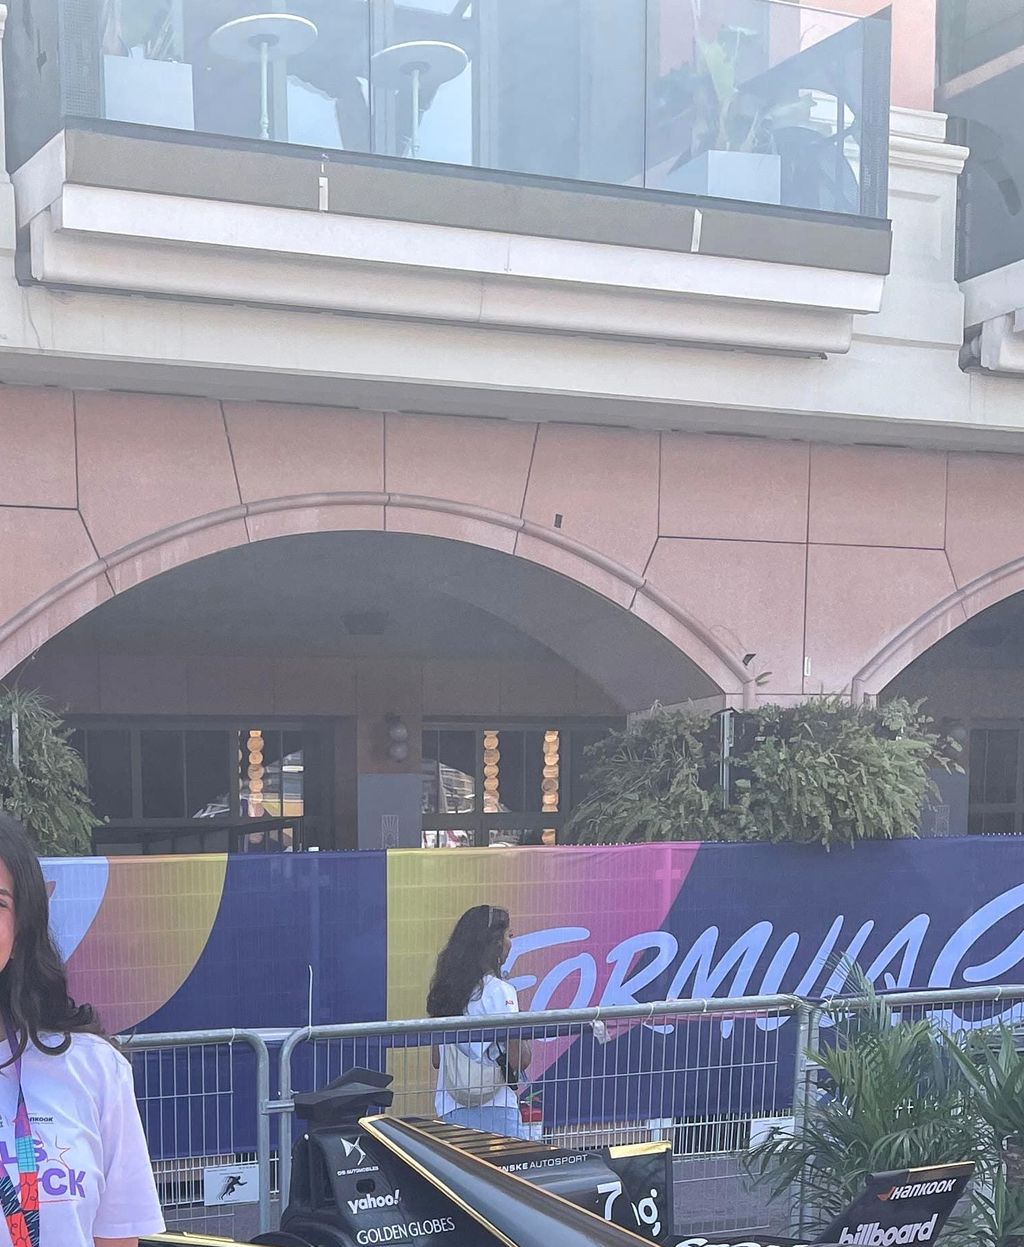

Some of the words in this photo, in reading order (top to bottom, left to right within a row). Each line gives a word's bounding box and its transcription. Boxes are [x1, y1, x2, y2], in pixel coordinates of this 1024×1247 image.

[529, 1154, 589, 1169] AUTOSPORT
[347, 1190, 400, 1215] yahoo!
[356, 1224, 408, 1245] GOLDEN
[408, 1217, 456, 1237] GLOBES
[838, 1213, 939, 1247] billboard
